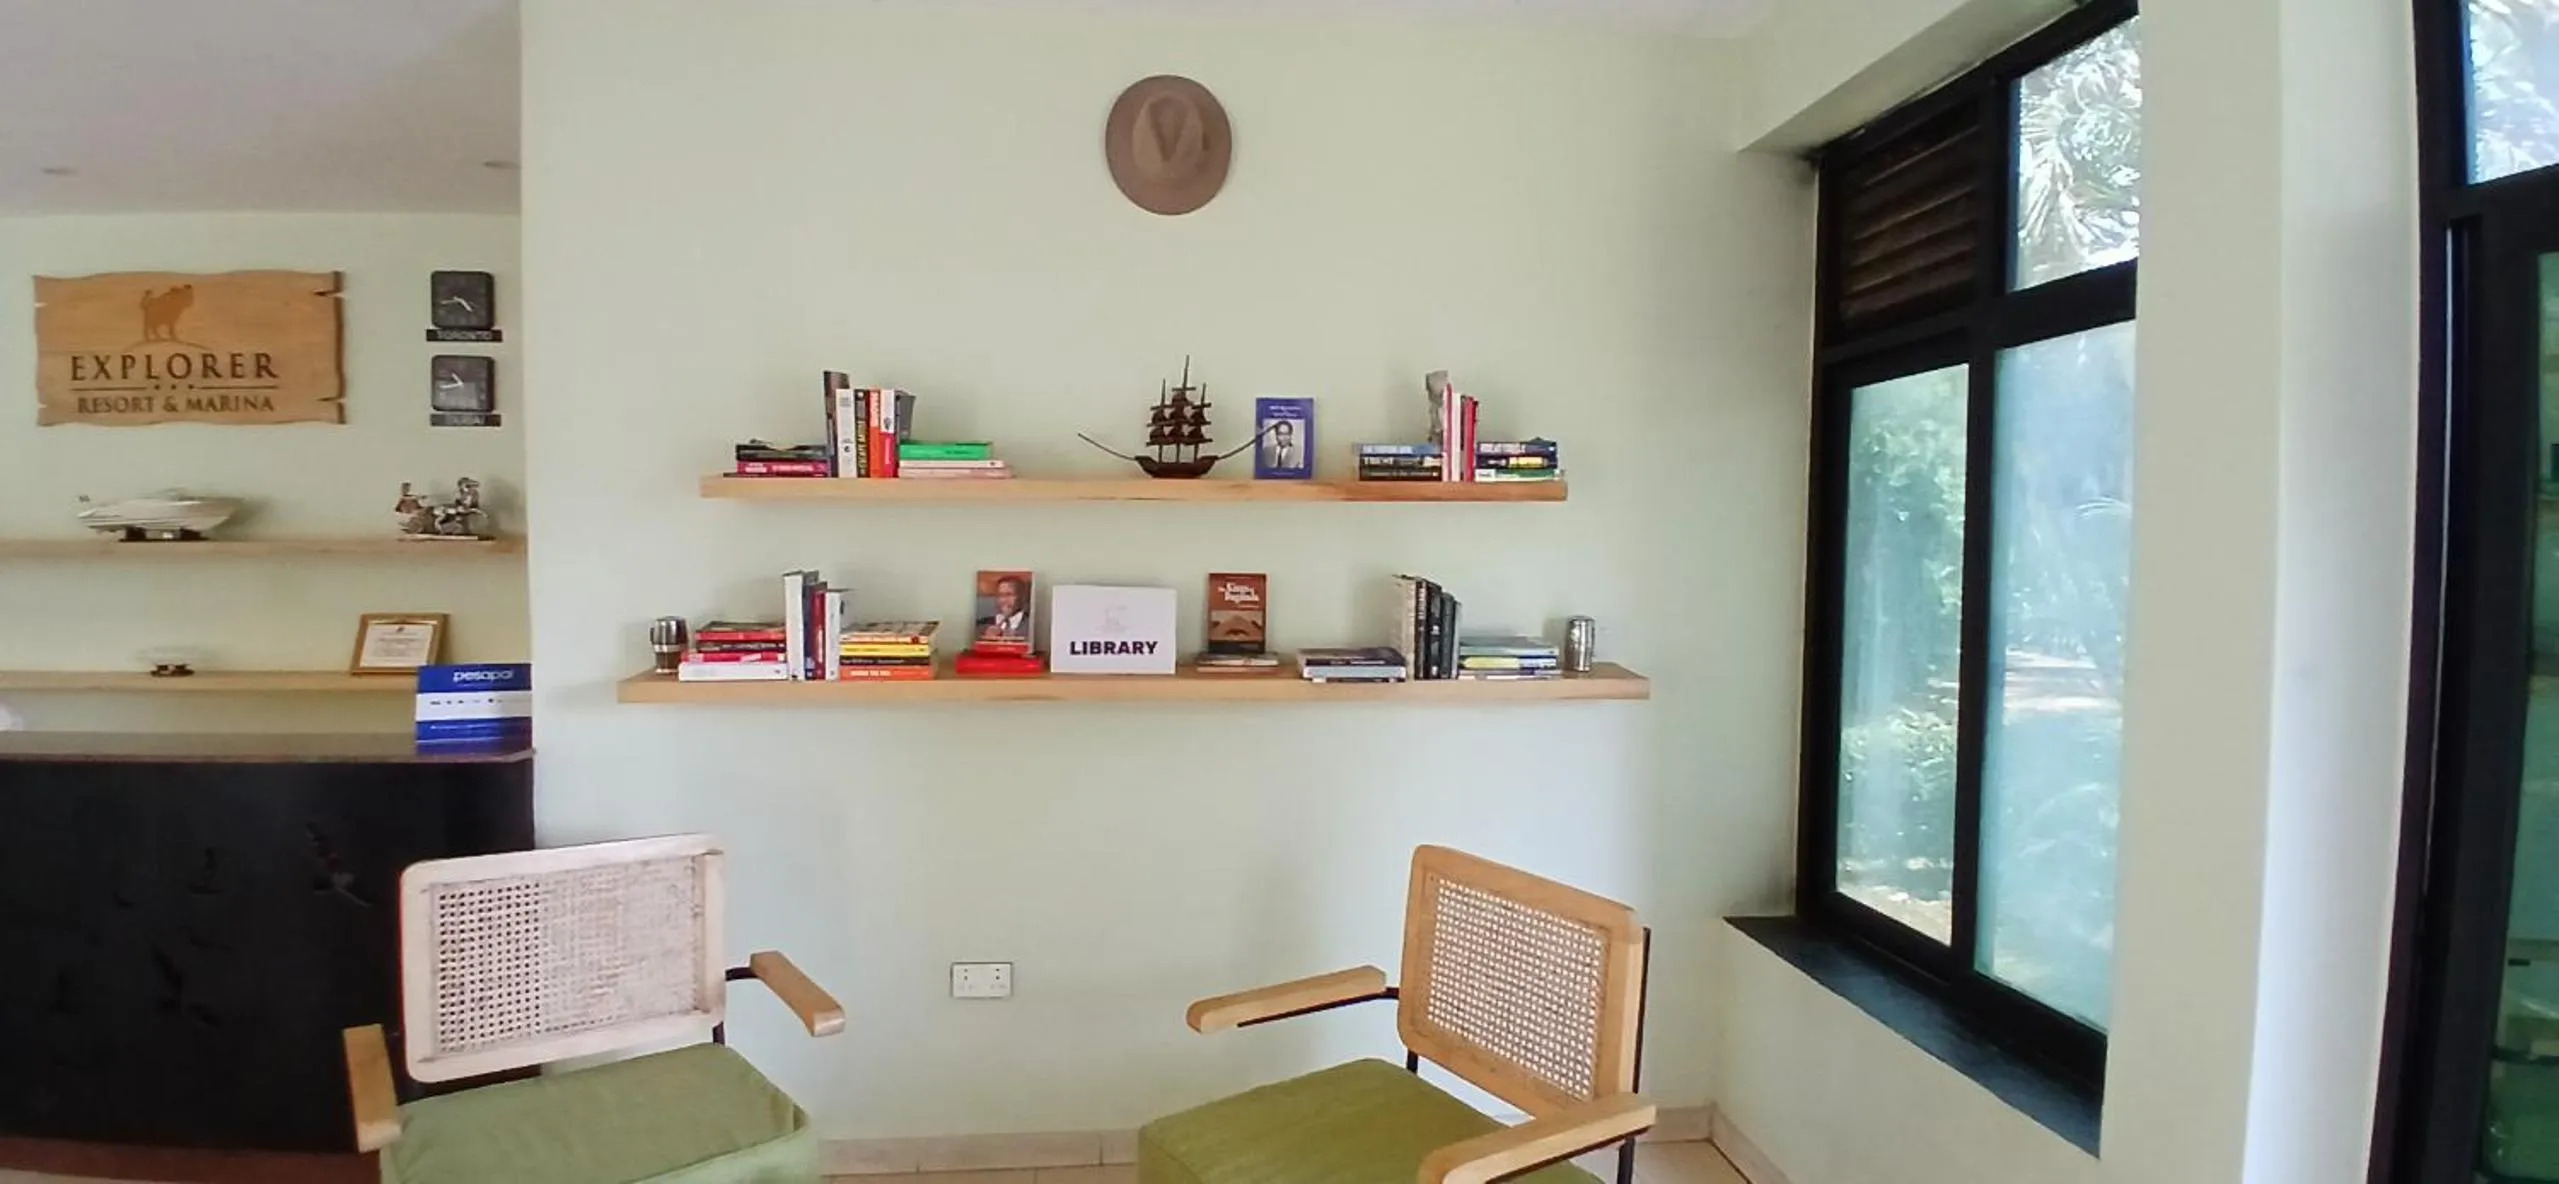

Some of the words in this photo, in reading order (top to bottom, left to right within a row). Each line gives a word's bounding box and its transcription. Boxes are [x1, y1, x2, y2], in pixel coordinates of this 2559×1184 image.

[70, 352, 280, 382] EXPLORER
[77, 394, 156, 414] RESORT
[162, 395, 179, 412] &
[185, 394, 275, 412] MARINA
[1069, 640, 1159, 656] LIBRARY
